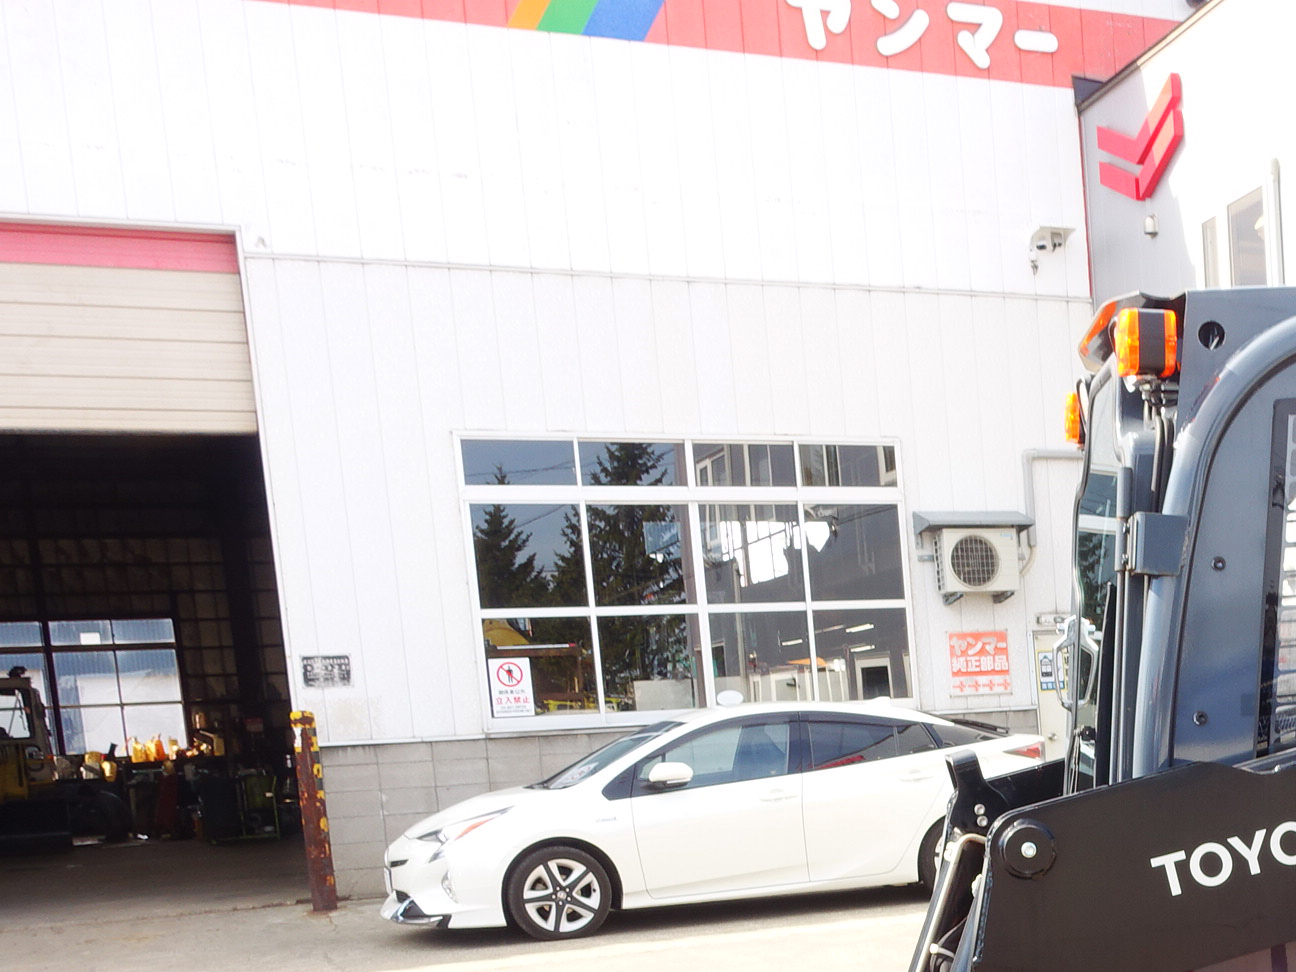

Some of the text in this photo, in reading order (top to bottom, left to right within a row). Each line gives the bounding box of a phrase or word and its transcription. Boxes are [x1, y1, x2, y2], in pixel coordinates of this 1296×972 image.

[950, 636, 1007, 656] ヤンマー
[952, 655, 1009, 673] 純正部品
[496, 696, 530, 705] 立入禁止
